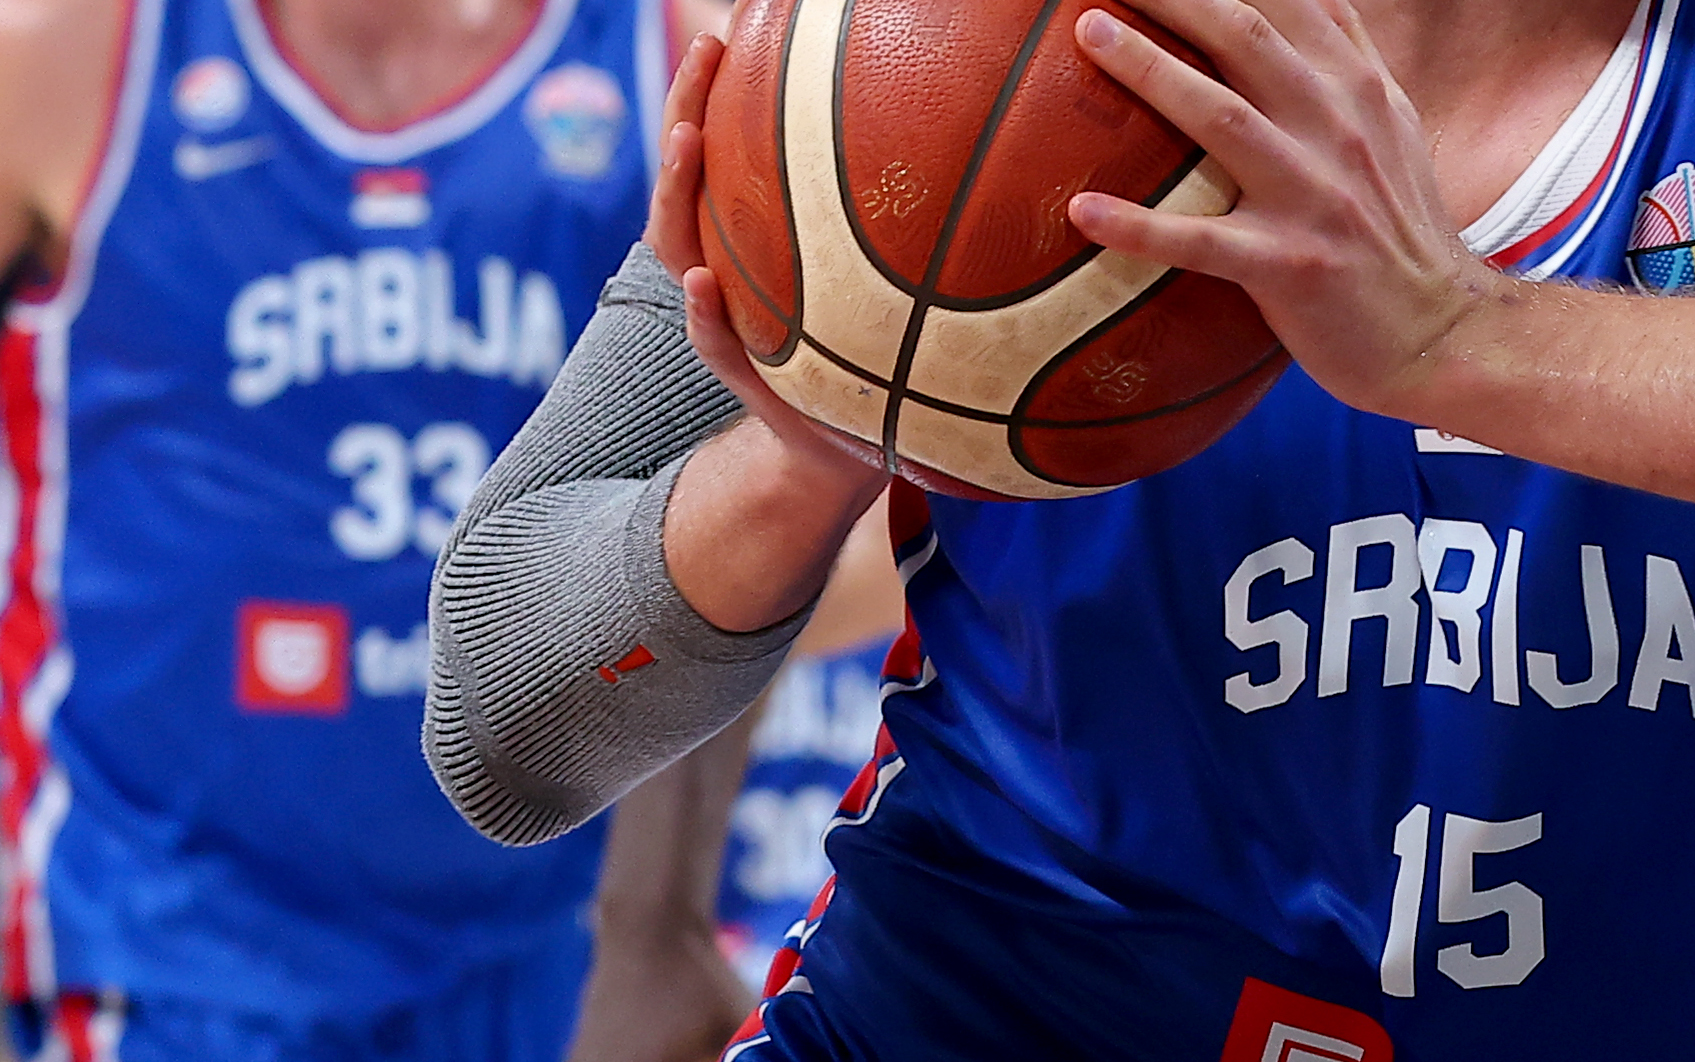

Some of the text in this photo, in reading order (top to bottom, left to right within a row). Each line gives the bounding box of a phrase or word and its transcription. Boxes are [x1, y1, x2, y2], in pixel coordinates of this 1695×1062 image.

[226, 247, 566, 407] SRBIJA
[327, 421, 492, 560] 33
[1380, 803, 1545, 998] 15
